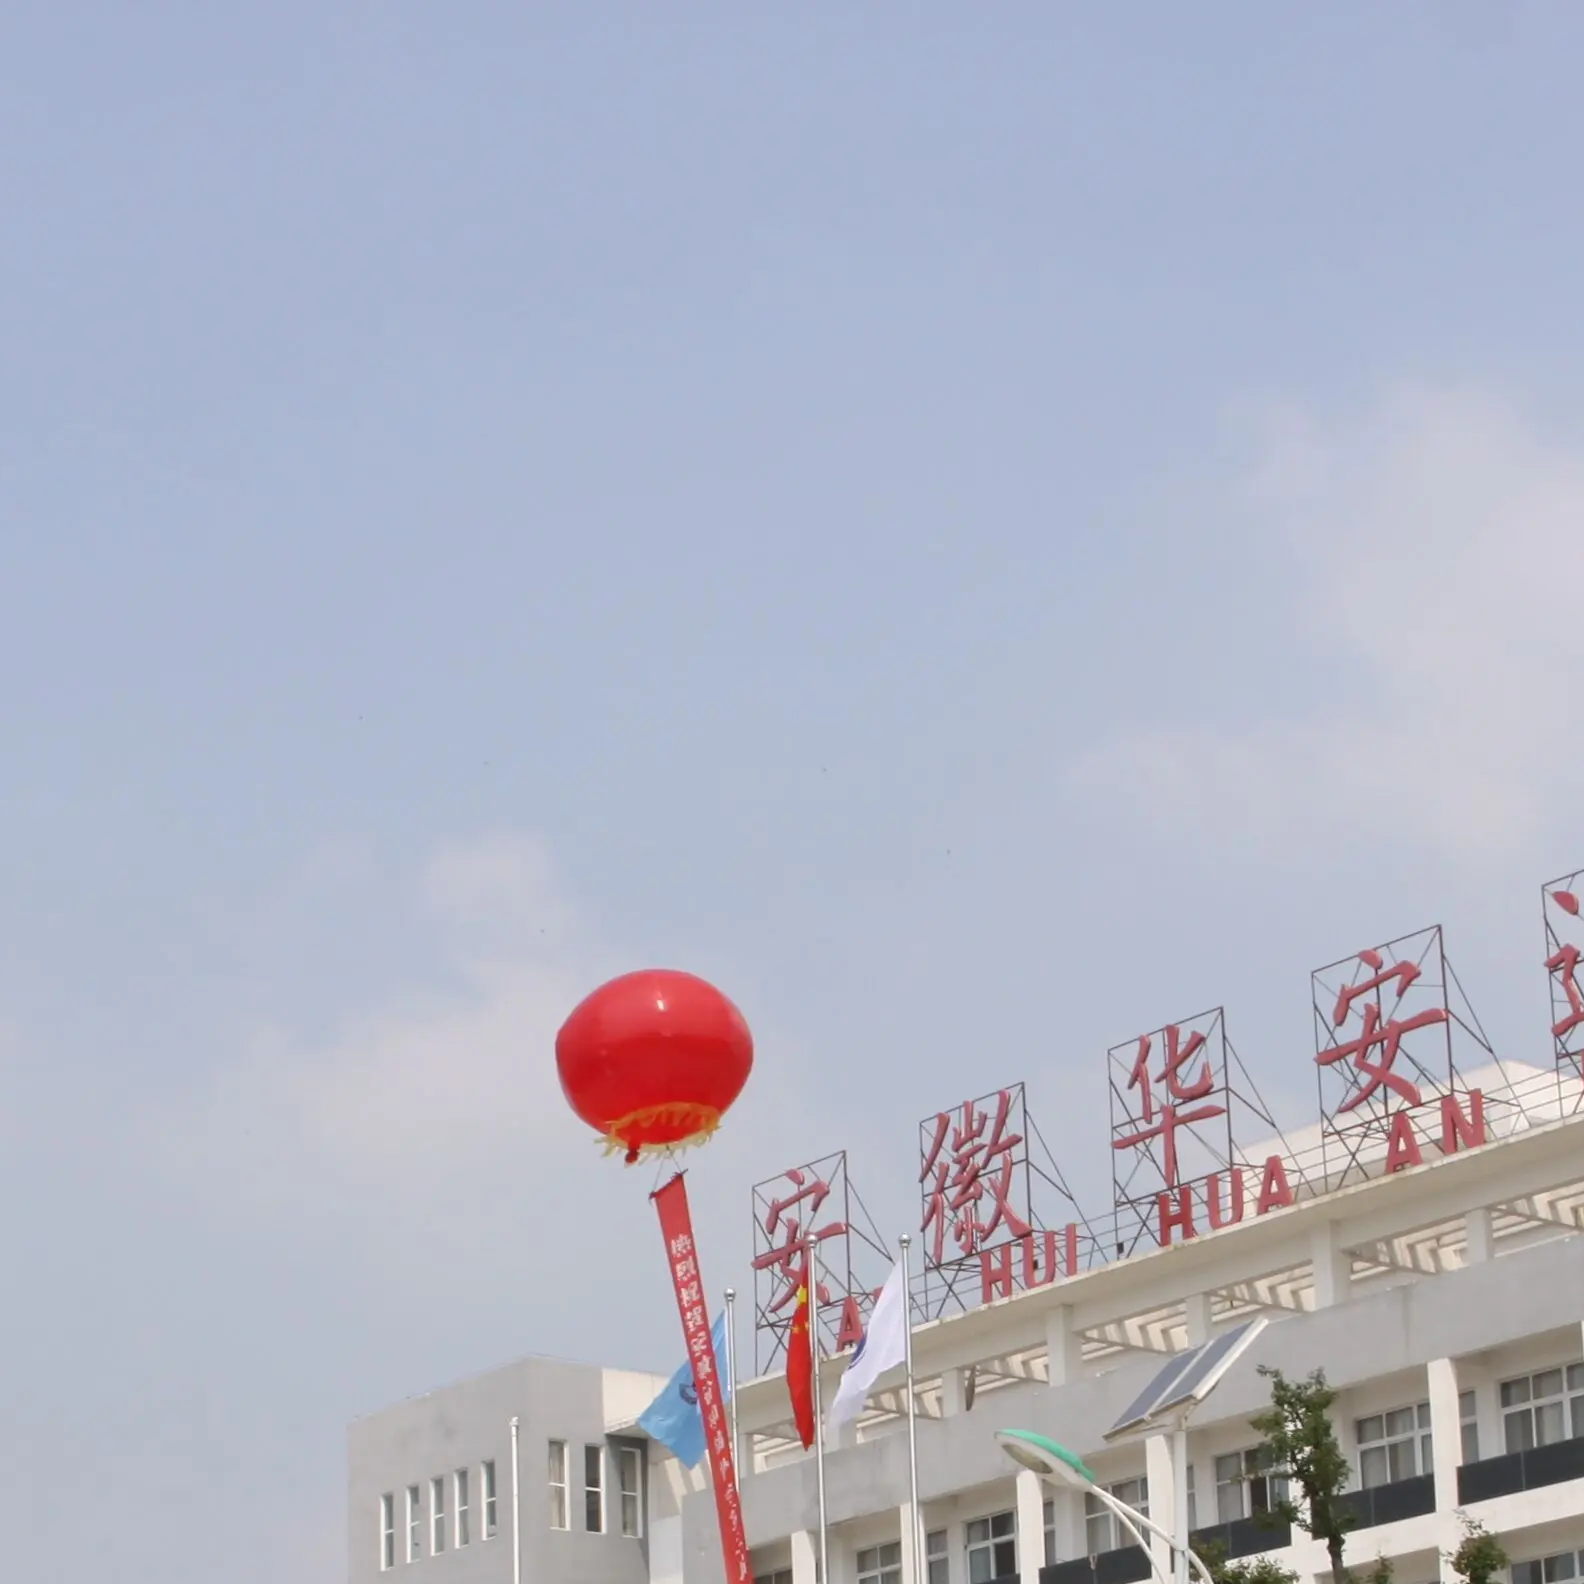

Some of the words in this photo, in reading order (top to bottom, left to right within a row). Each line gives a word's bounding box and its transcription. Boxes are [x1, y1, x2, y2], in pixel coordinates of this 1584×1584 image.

[980, 1223, 1077, 1303] HUI
[1157, 1155, 1294, 1247] HUA
[1384, 1088, 1487, 1174] AN
